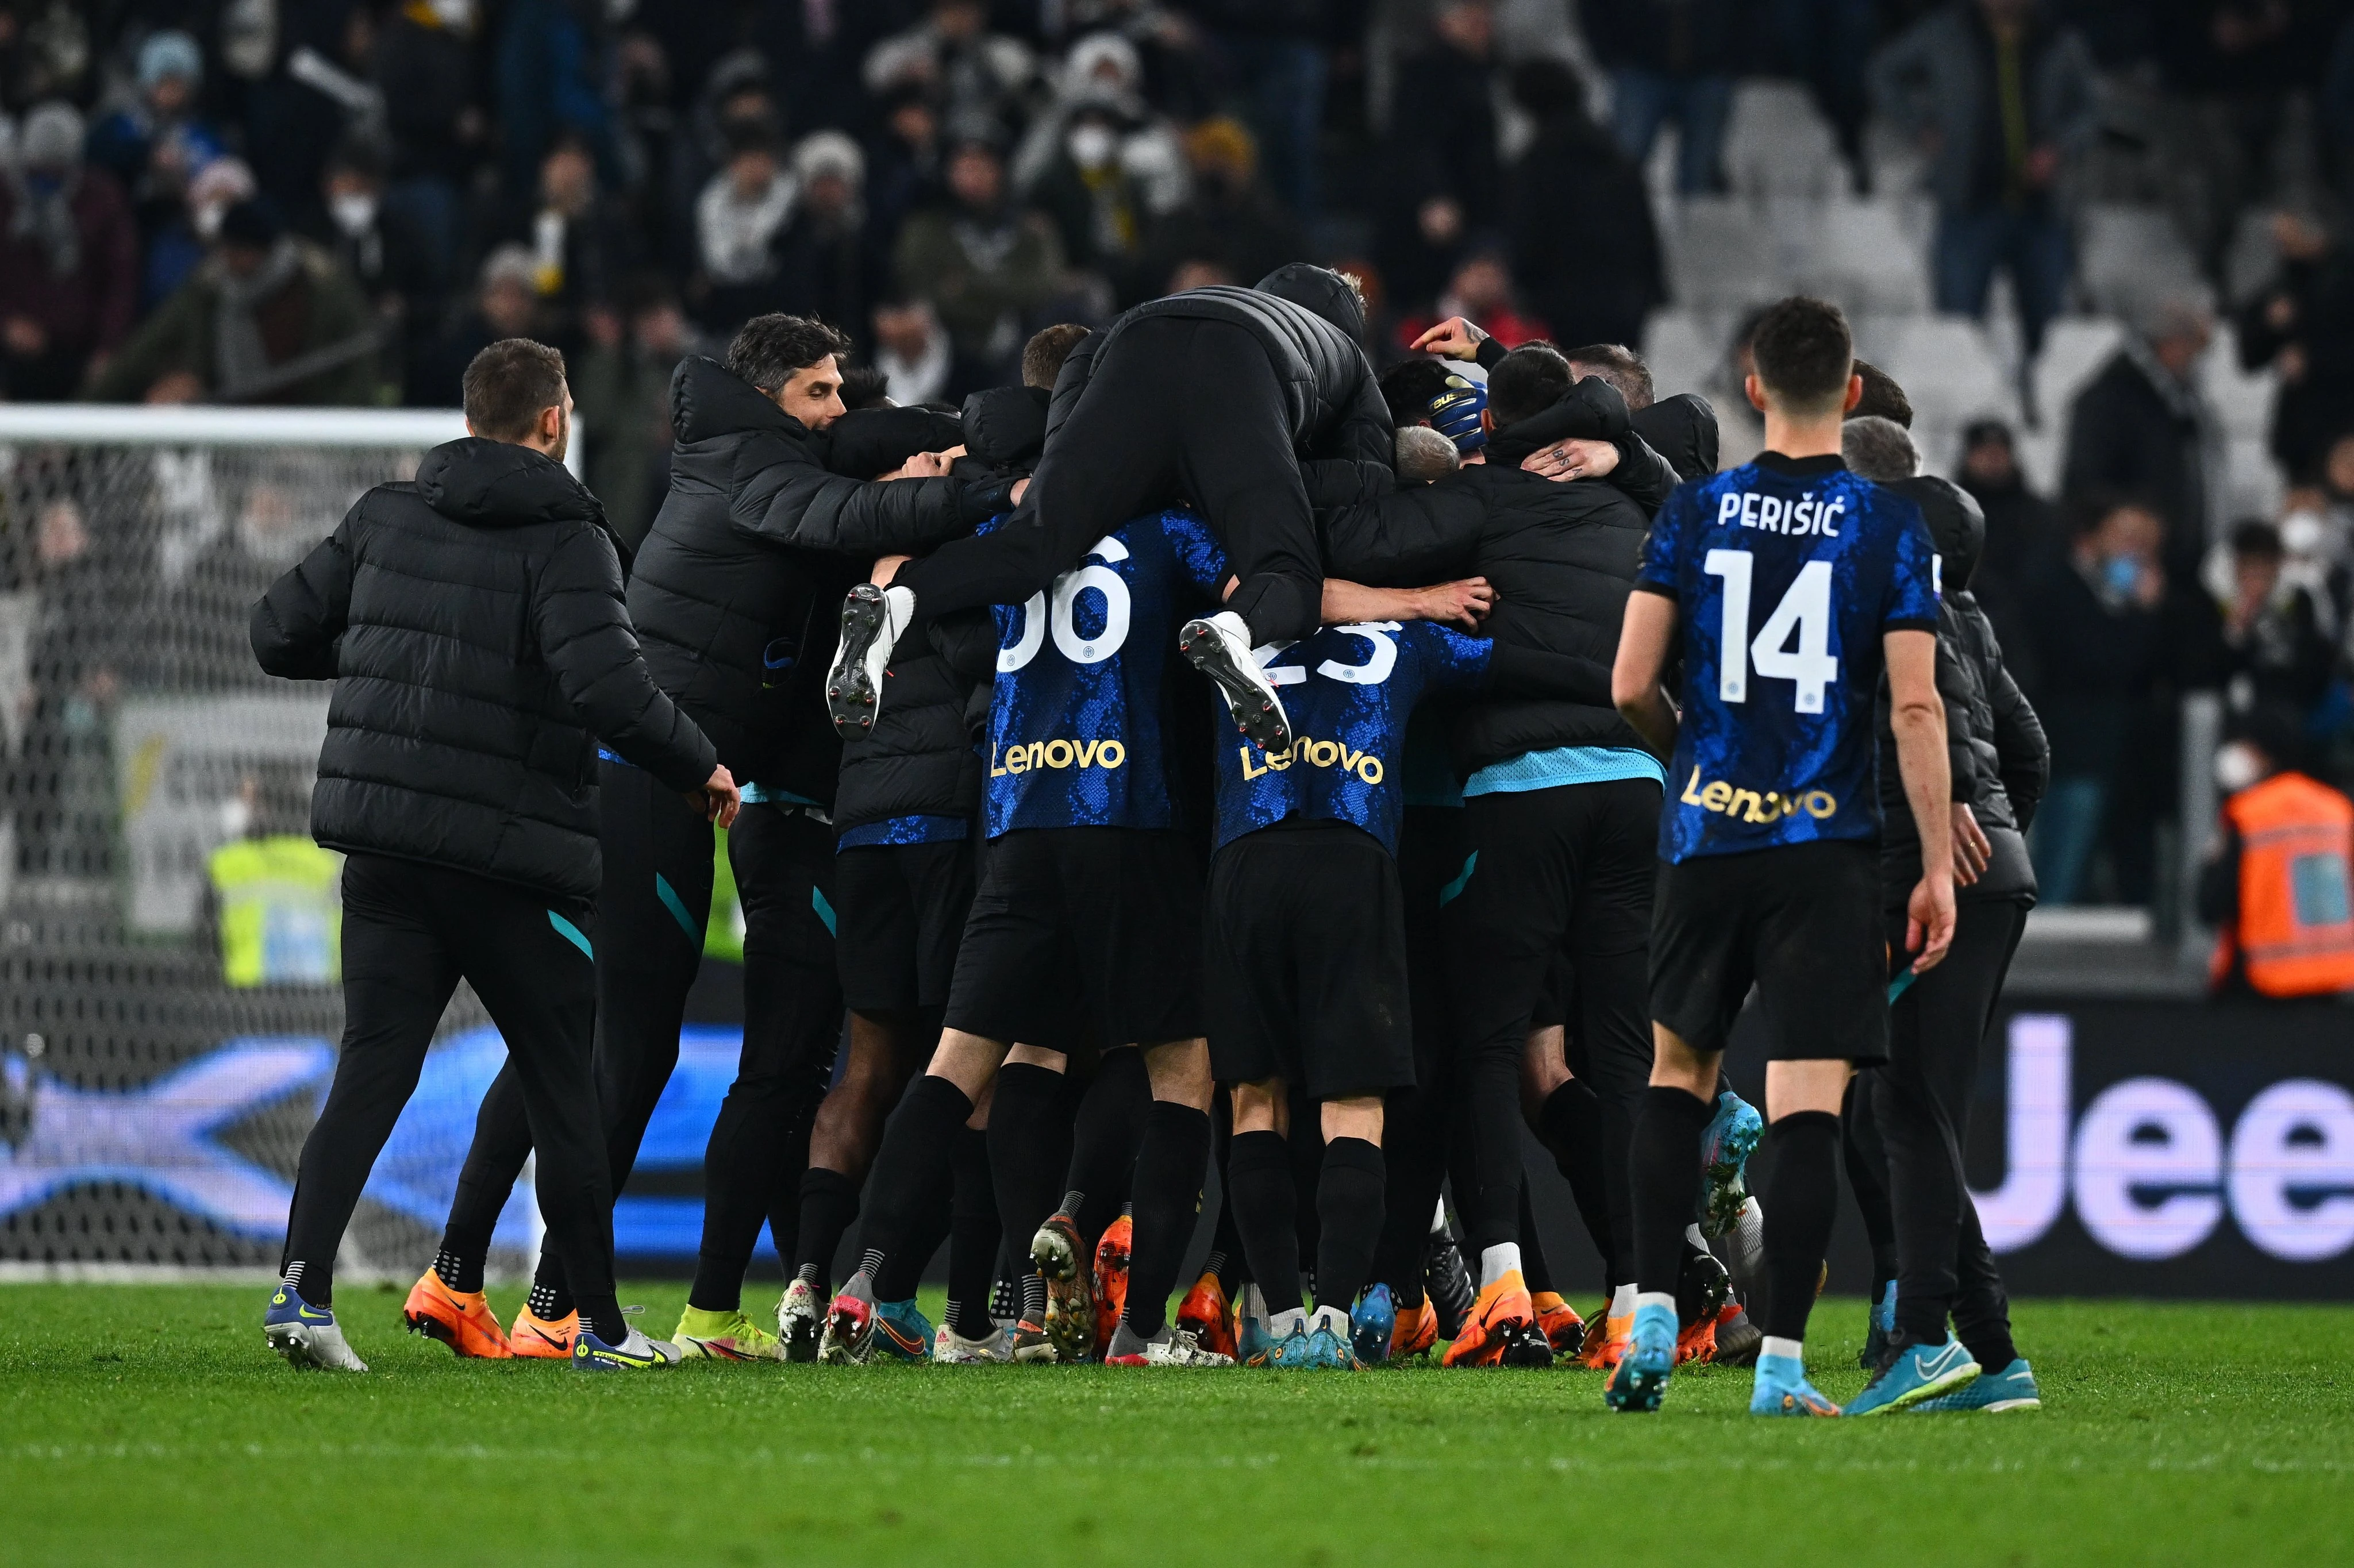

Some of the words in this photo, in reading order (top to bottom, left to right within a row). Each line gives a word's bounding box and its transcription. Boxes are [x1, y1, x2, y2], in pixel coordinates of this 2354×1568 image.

[1717, 491, 1845, 538] PERIŠIĆ
[1703, 548, 1838, 714] 14
[990, 739, 1125, 778] Lenovo
[1240, 736, 1383, 784] Lenovo
[1680, 764, 1837, 823] Lenovo
[1964, 1011, 2354, 1262] Jee
